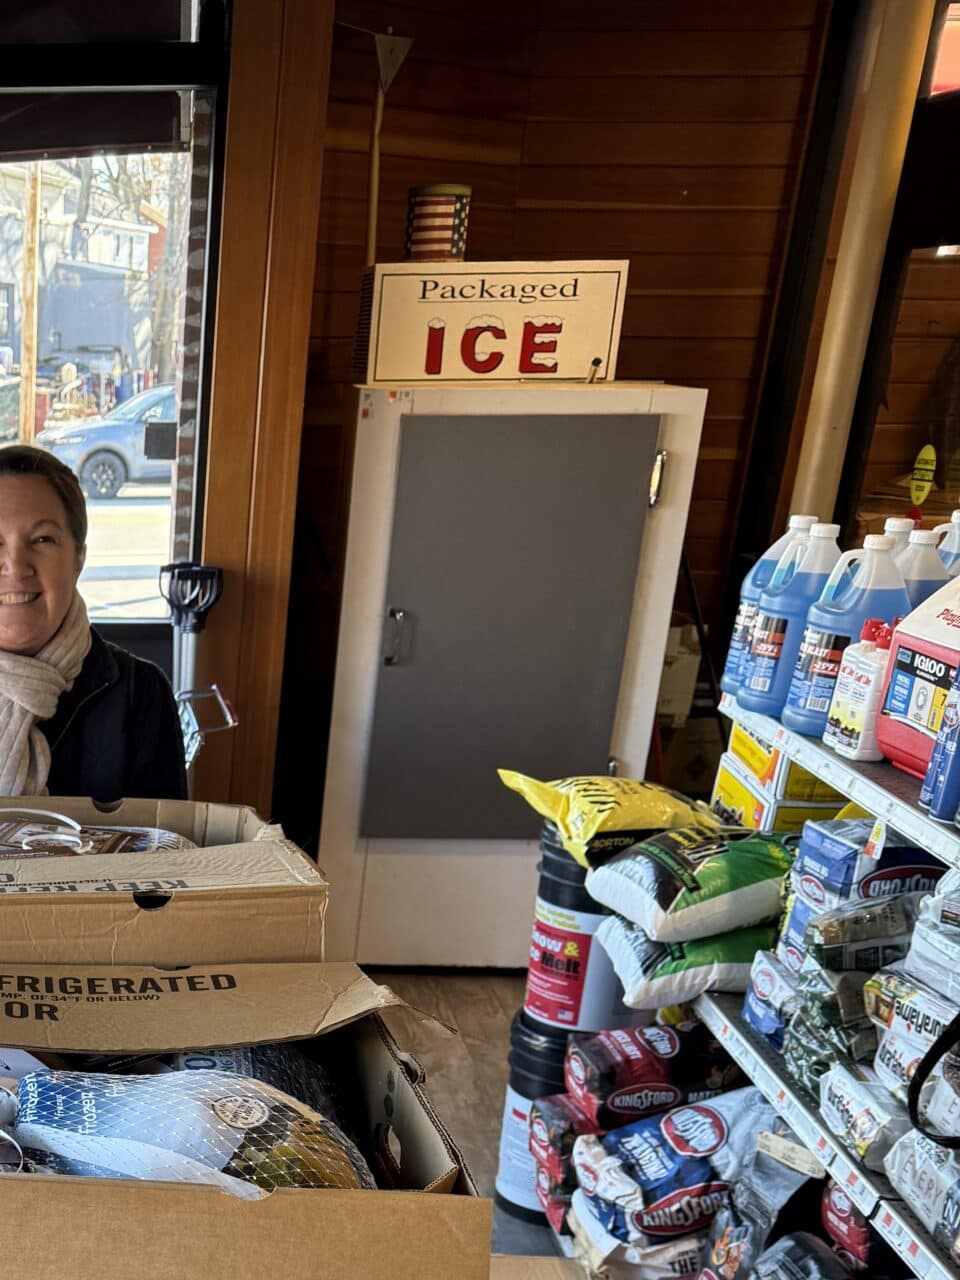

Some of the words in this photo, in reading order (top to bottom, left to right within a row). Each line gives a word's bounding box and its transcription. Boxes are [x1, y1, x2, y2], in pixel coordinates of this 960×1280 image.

[417, 278, 580, 304] Packaged
[424, 314, 564, 376] ICE
[564, 942, 580, 957] &
[111, 994, 161, 1004] BELOW)
[4, 1001, 60, 1021] OR
[613, 1089, 675, 1109] KINGSFORD
[670, 1257, 698, 1275] THE
